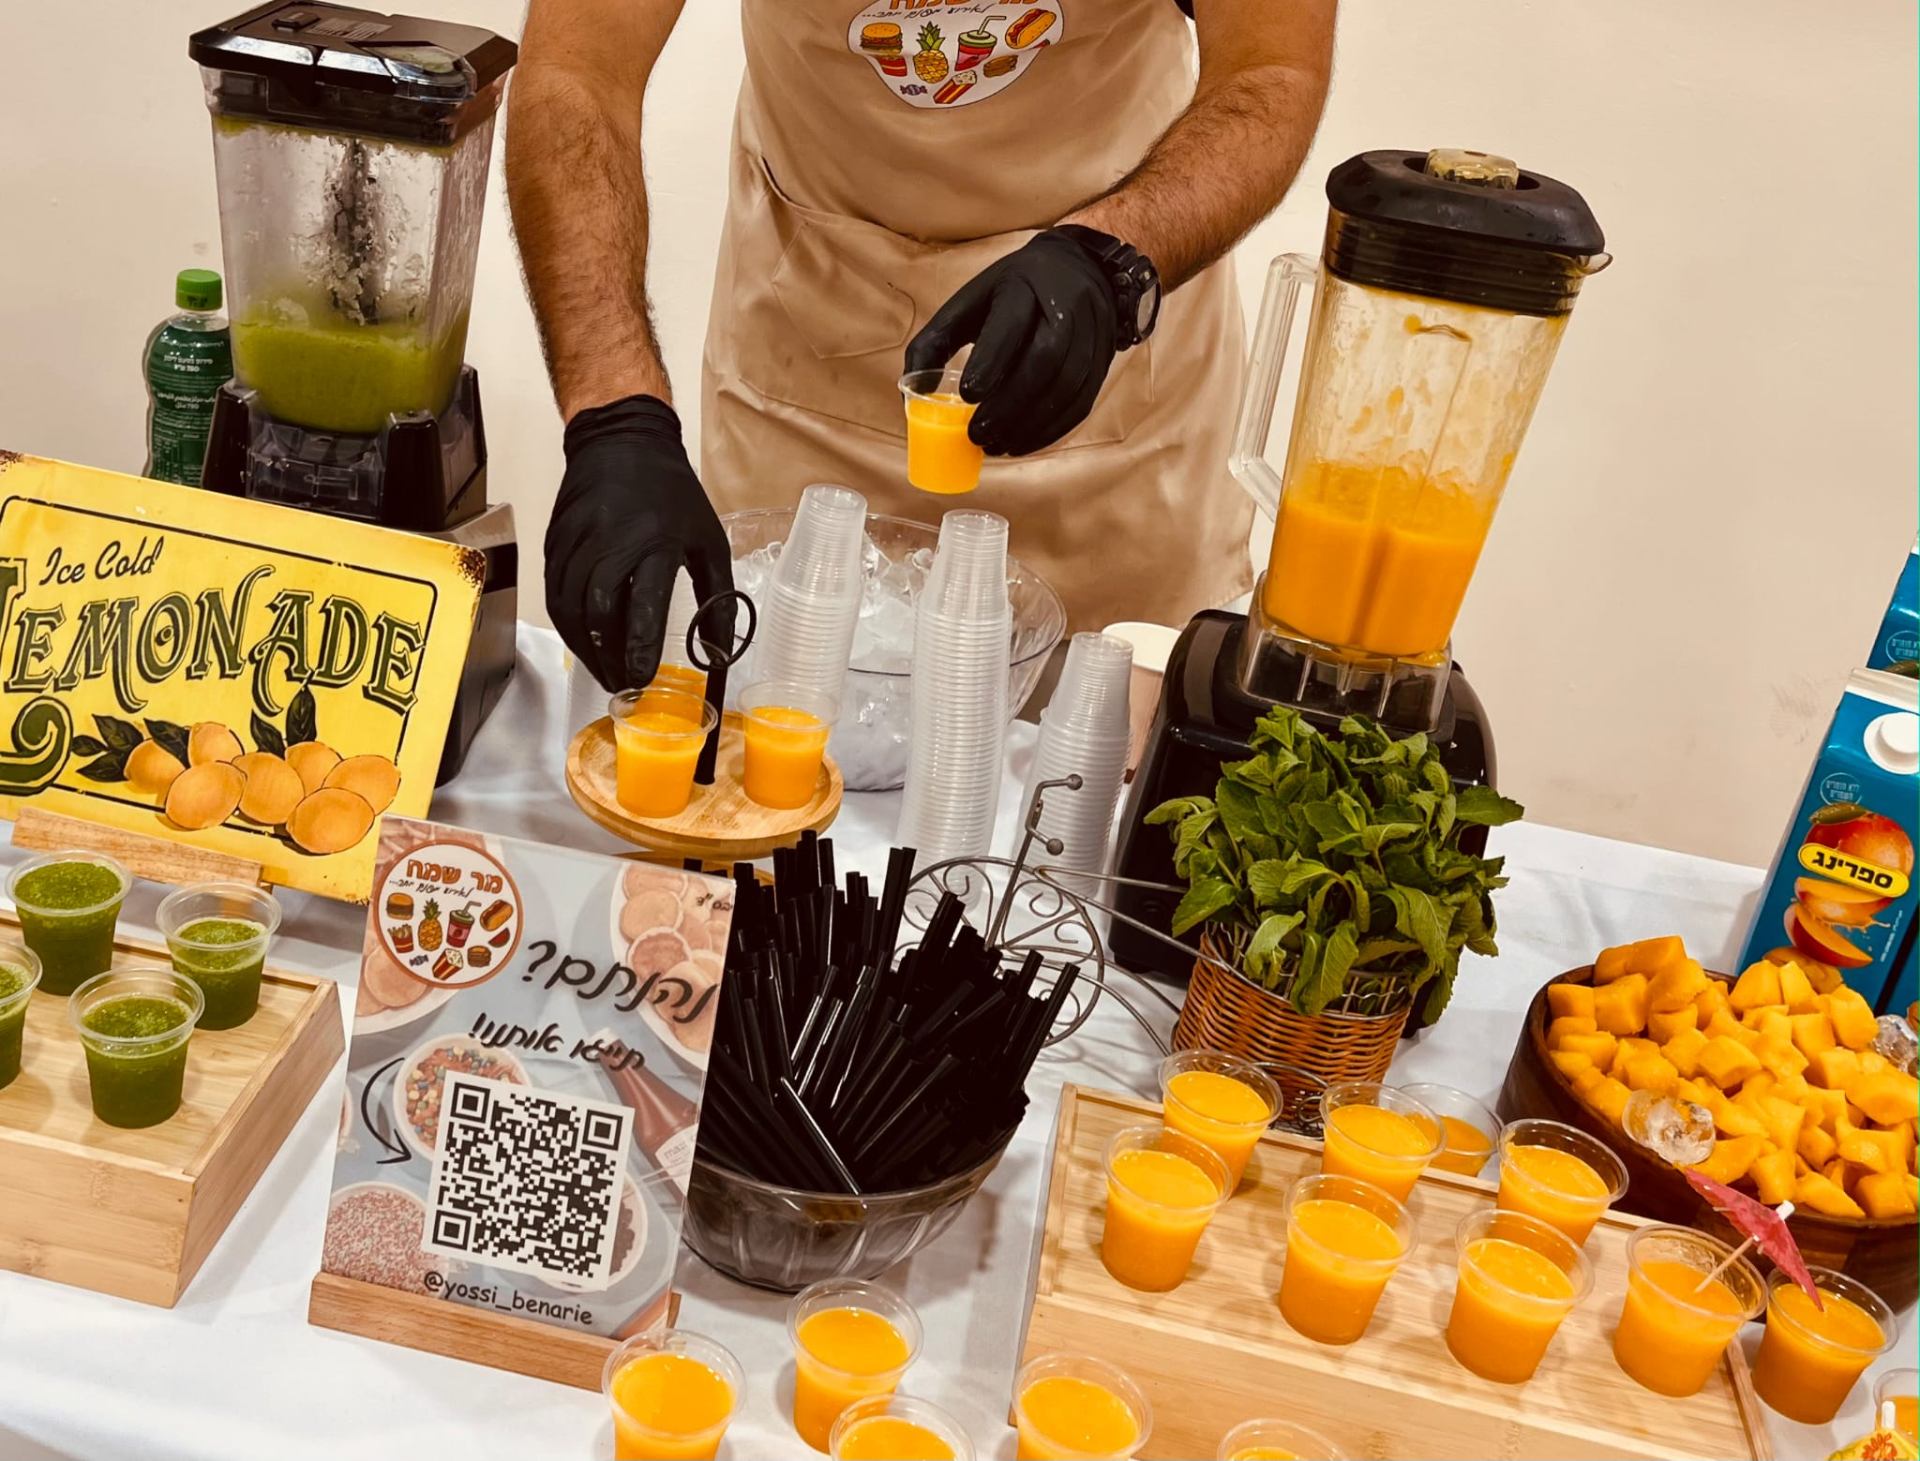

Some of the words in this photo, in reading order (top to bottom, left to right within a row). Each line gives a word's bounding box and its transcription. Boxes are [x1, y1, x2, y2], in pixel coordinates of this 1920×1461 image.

[39, 547, 86, 586] Ice
[95, 536, 164, 580] Cold
[406, 859, 462, 884] שמח
[471, 871, 503, 894] מר
[1810, 849, 1893, 890] ספרינג
[424, 1271, 593, 1325] @yossi_benarie
